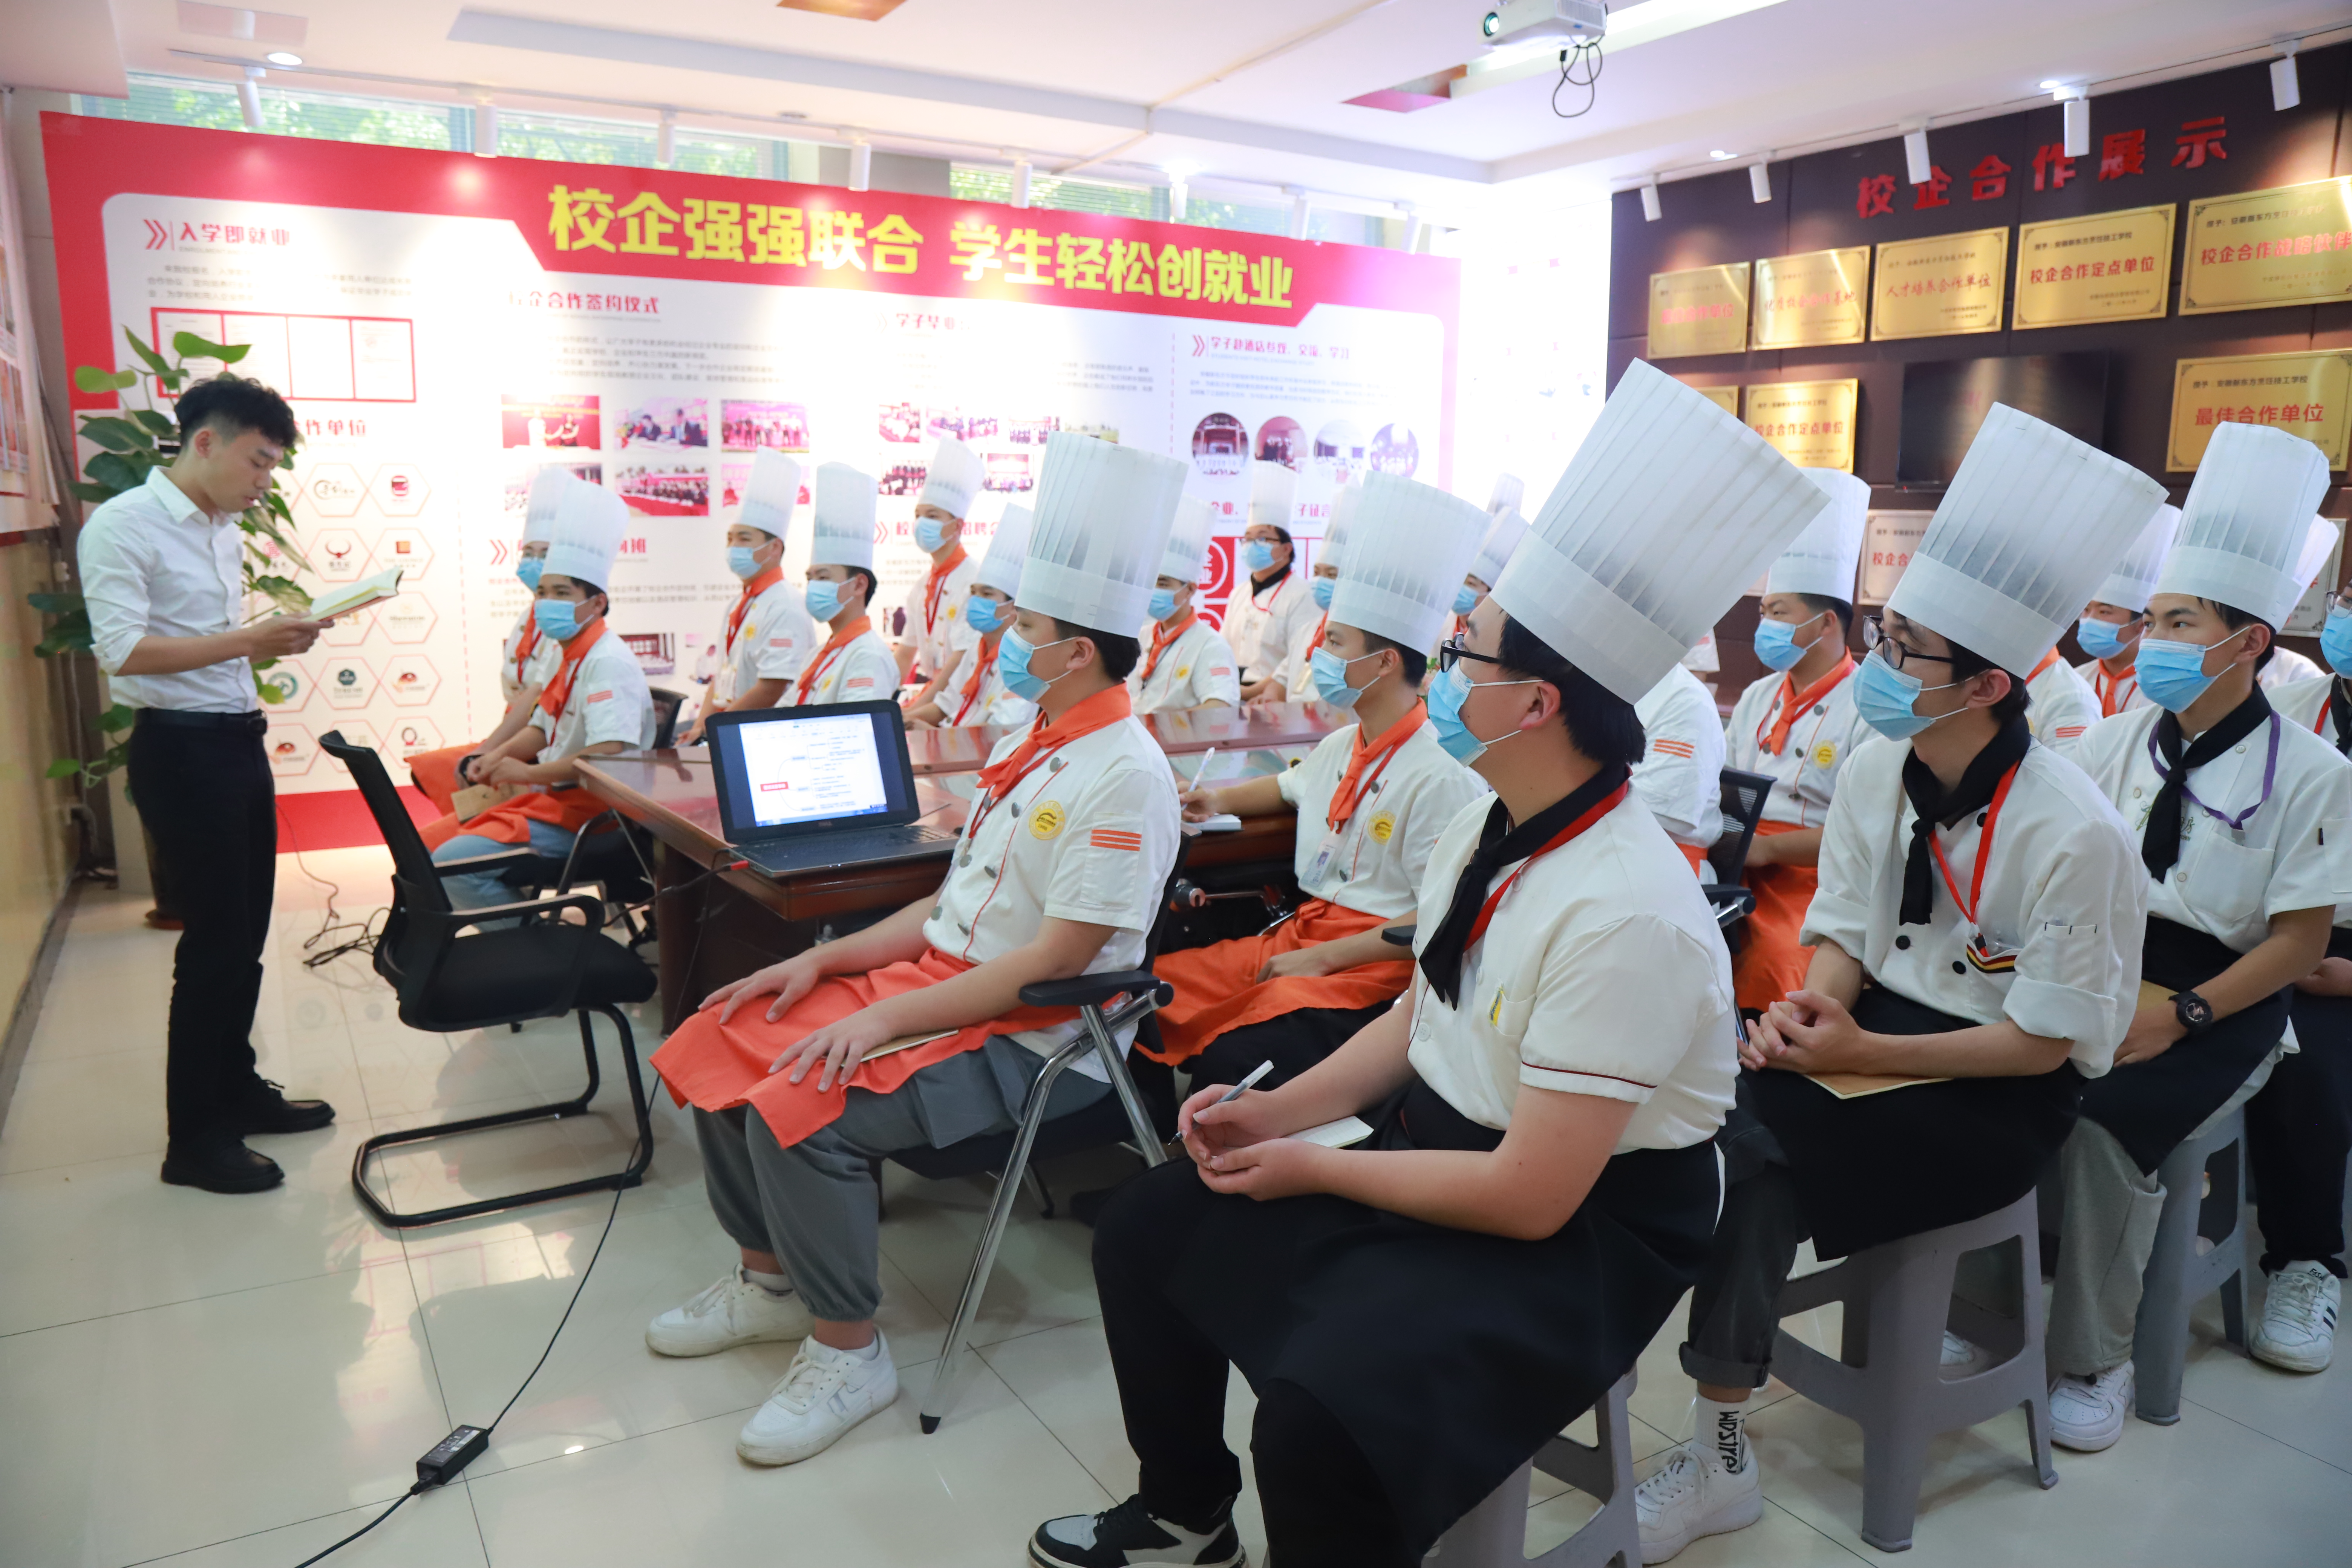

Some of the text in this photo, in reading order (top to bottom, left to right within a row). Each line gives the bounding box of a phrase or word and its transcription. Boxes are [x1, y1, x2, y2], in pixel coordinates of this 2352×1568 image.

[1856, 116, 2227, 218] 校企合作展示
[179, 222, 290, 246] 入学即就业
[547, 184, 1293, 309] 校企强强联合 学生轻松创就业
[2030, 256, 2155, 285] 校企合作定点单位
[2196, 403, 2324, 426] 最佳合作单位
